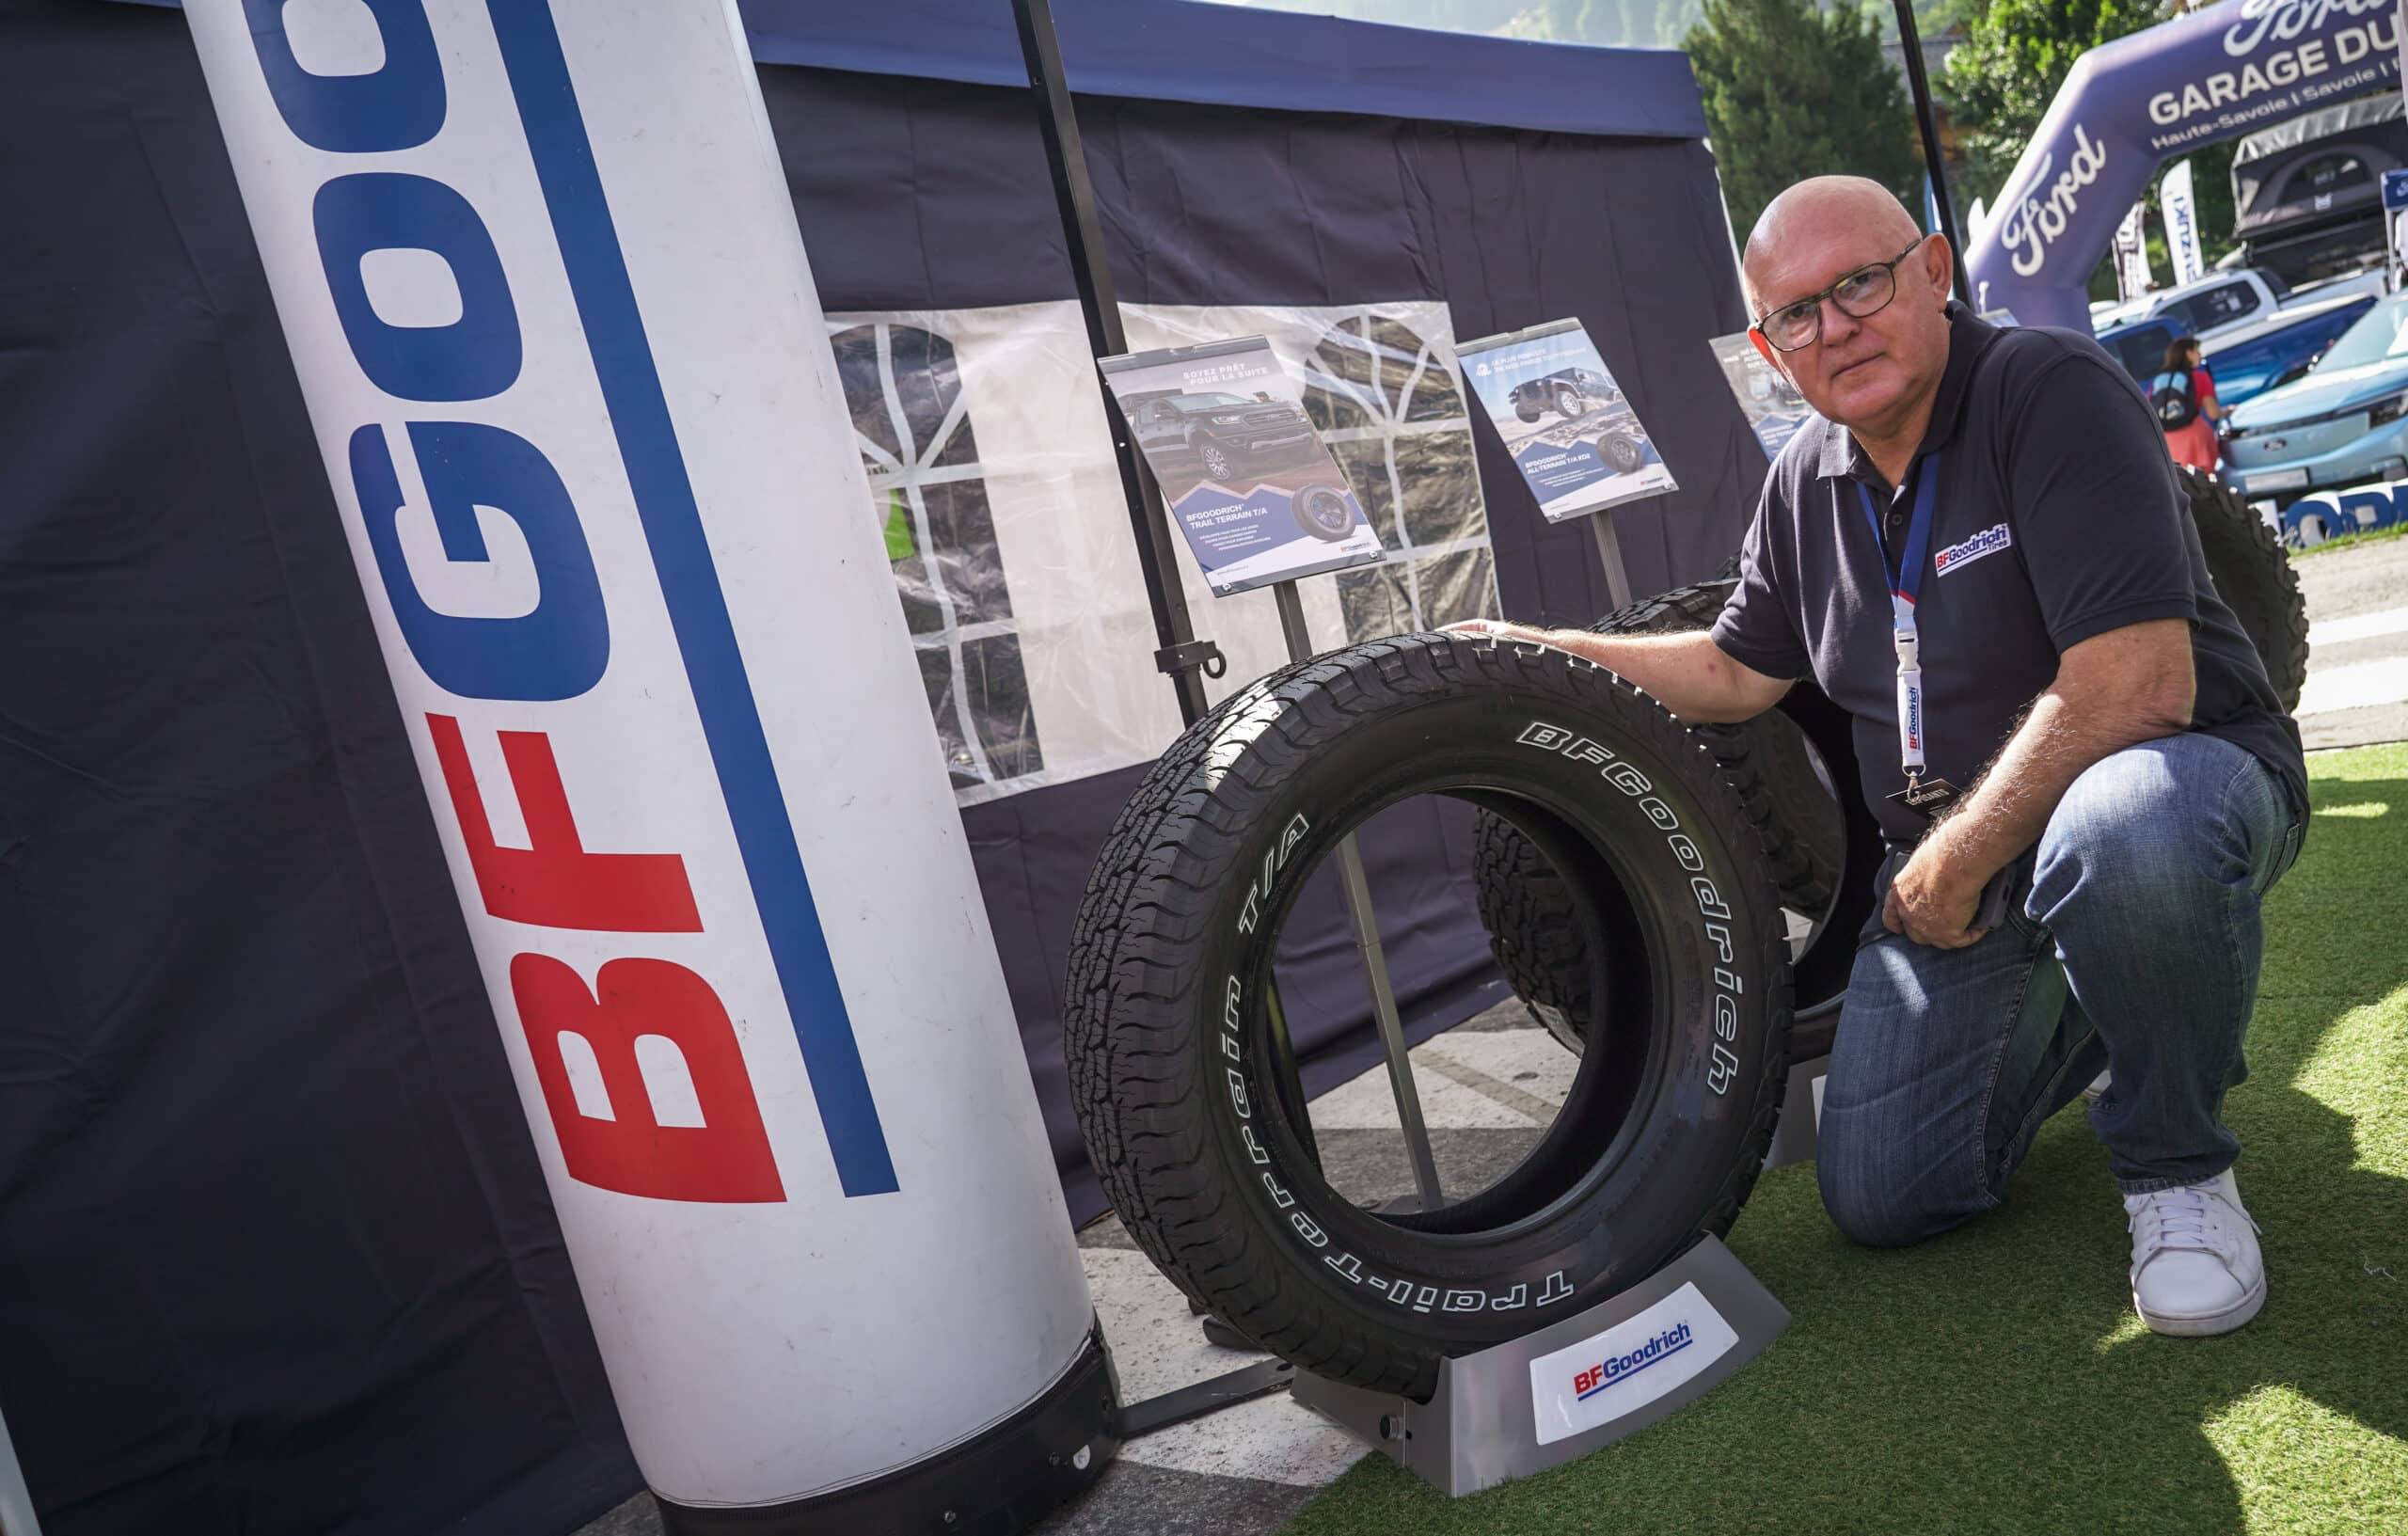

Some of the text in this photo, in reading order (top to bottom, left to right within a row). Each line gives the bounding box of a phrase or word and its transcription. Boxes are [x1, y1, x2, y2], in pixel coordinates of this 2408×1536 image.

[2148, 11, 2399, 125] GARAGE DU
[2152, 98, 2289, 150] Haute-Savoie
[2302, 69, 2376, 101] Savoie
[2002, 123, 2106, 277] Ford
[1189, 507, 1268, 530] TRAIL TERRAIN T/A
[1937, 528, 2006, 568] BFGoodrich
[1909, 687, 1918, 750] BFGoodrich
[1516, 721, 1743, 1096] BFGoodrich
[1219, 812, 1576, 1312] Trail-Terrain T/A
[1574, 1322, 1690, 1395] BFGoodrich
